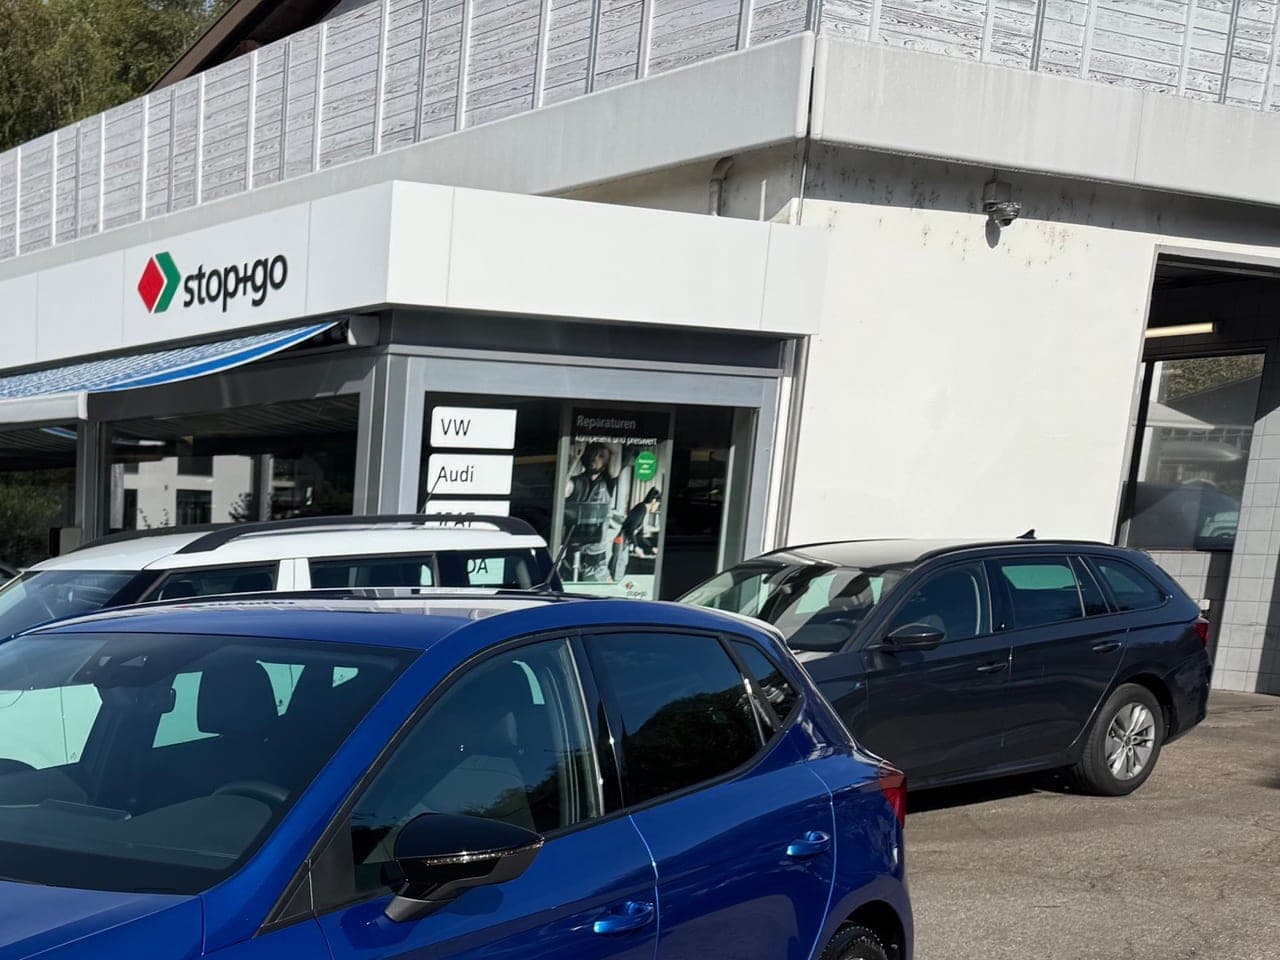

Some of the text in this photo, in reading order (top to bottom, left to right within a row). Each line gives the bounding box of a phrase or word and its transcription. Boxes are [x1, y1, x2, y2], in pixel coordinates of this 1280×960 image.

[183, 254, 288, 313] stop+go
[440, 417, 471, 436] VW
[576, 415, 637, 430] Reparaturen
[438, 465, 475, 483] Audi
